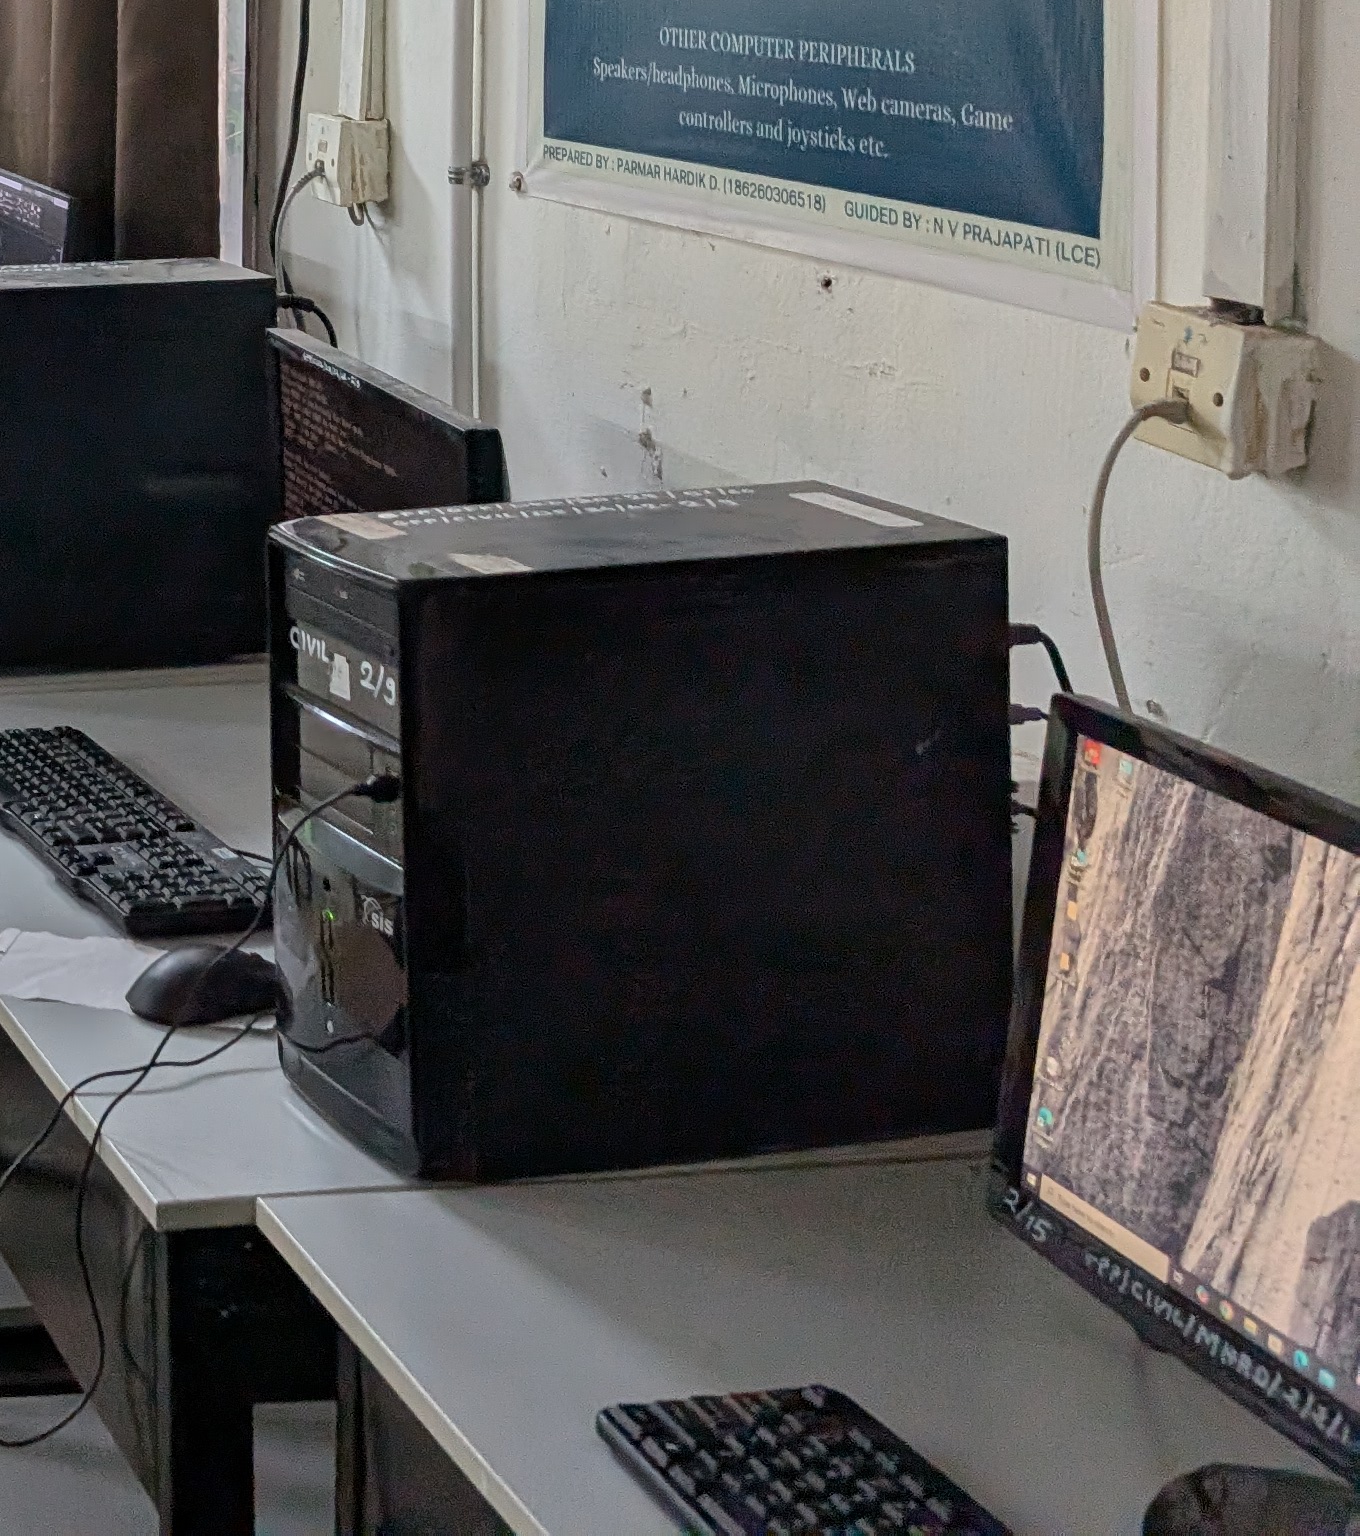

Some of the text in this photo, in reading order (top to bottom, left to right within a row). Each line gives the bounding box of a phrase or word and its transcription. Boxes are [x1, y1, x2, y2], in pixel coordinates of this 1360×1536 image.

[659, 26, 916, 74] OTHER COMPUTER PERIPHERALS
[593, 56, 1014, 132] Speakers/headphones, Microphones, Web cameras, Game
[679, 107, 889, 159] controllers and joysticks etc.
[543, 143, 1101, 270] PREPARED BY PARMAR HARDIK D. (186260306518) GUIDED BY N V PRAJAPATI (LCE)
[289, 624, 330, 665] CIVIL
